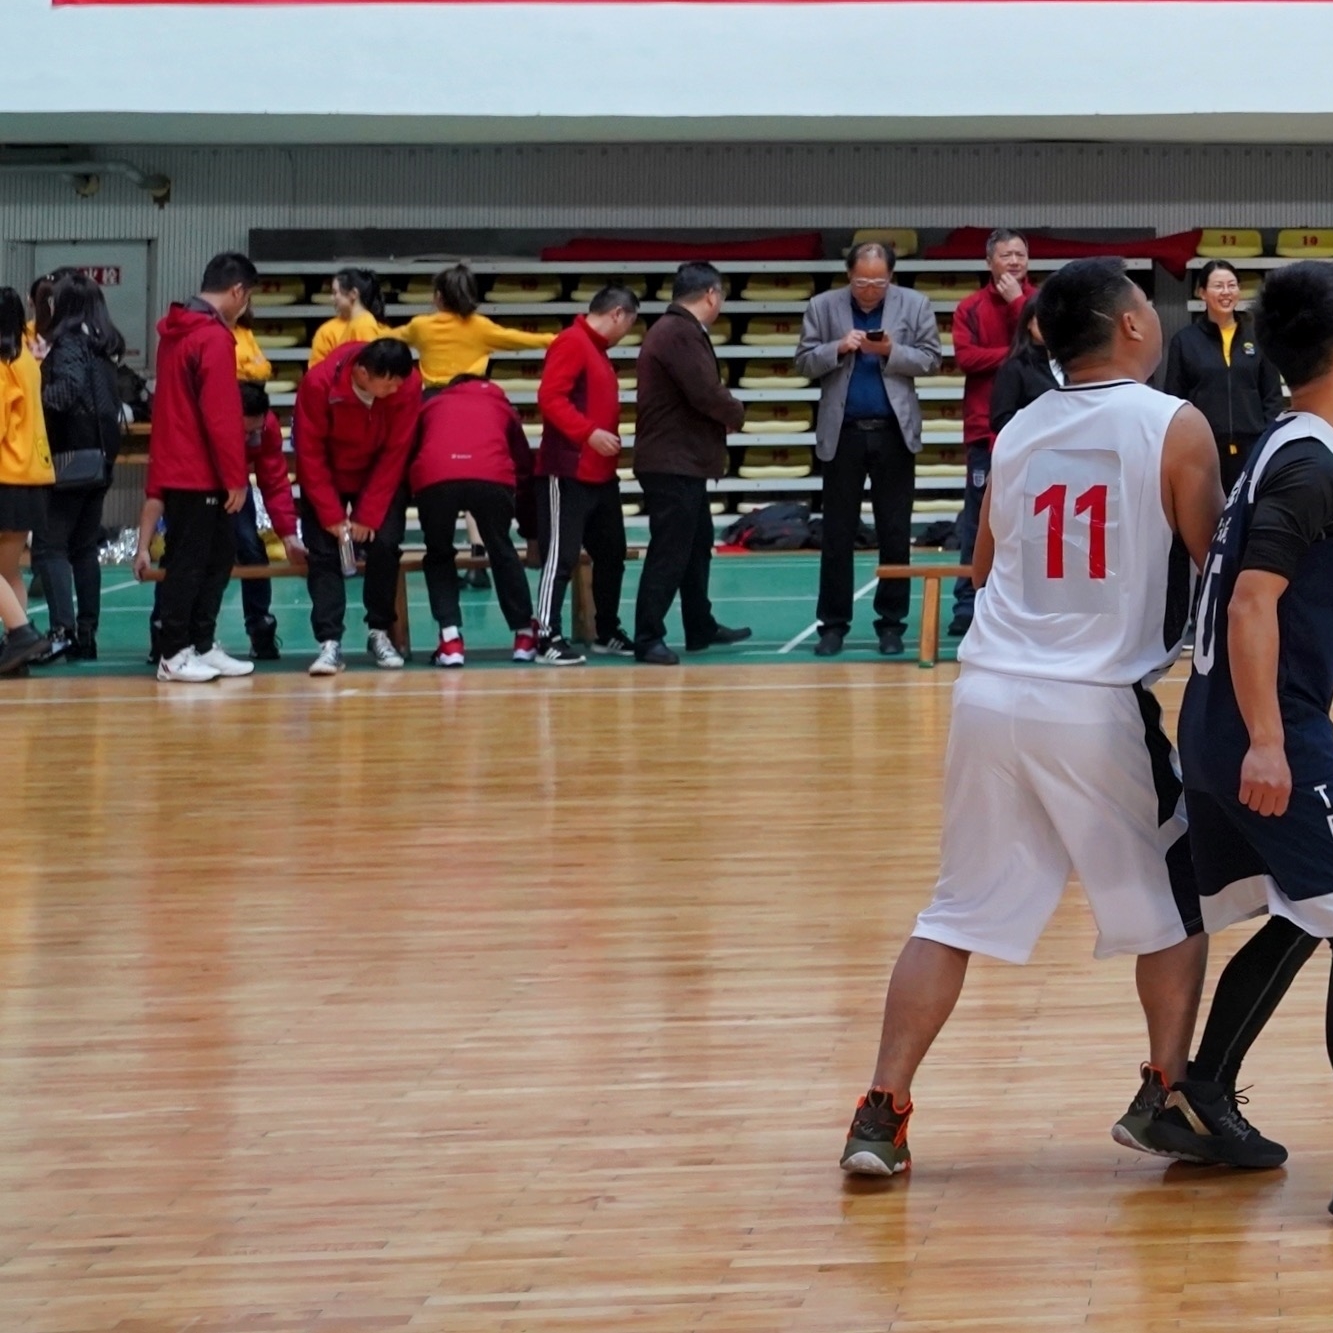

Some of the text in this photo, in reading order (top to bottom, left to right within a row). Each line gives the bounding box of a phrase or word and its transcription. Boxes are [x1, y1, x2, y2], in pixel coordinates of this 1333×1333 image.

[1221, 235, 1236, 246] 11
[1303, 236, 1318, 246] 10
[1033, 484, 1109, 580] 11
